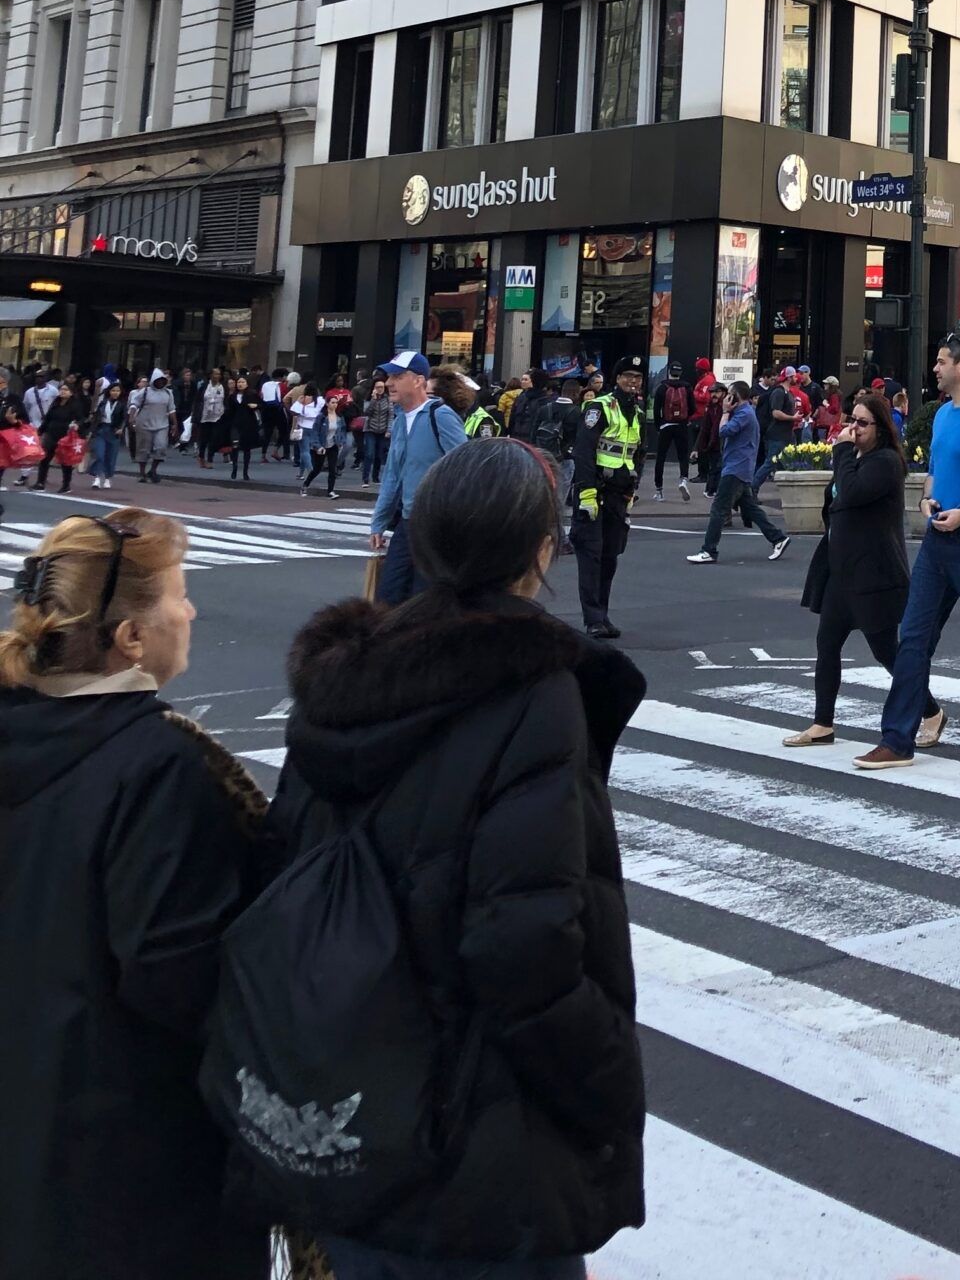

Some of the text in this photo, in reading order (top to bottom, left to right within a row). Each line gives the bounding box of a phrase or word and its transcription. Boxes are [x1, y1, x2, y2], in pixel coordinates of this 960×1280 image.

[432, 166, 558, 218] sunglass hut
[856, 182, 905, 197] West 34th St
[111, 236, 199, 265] macy's
